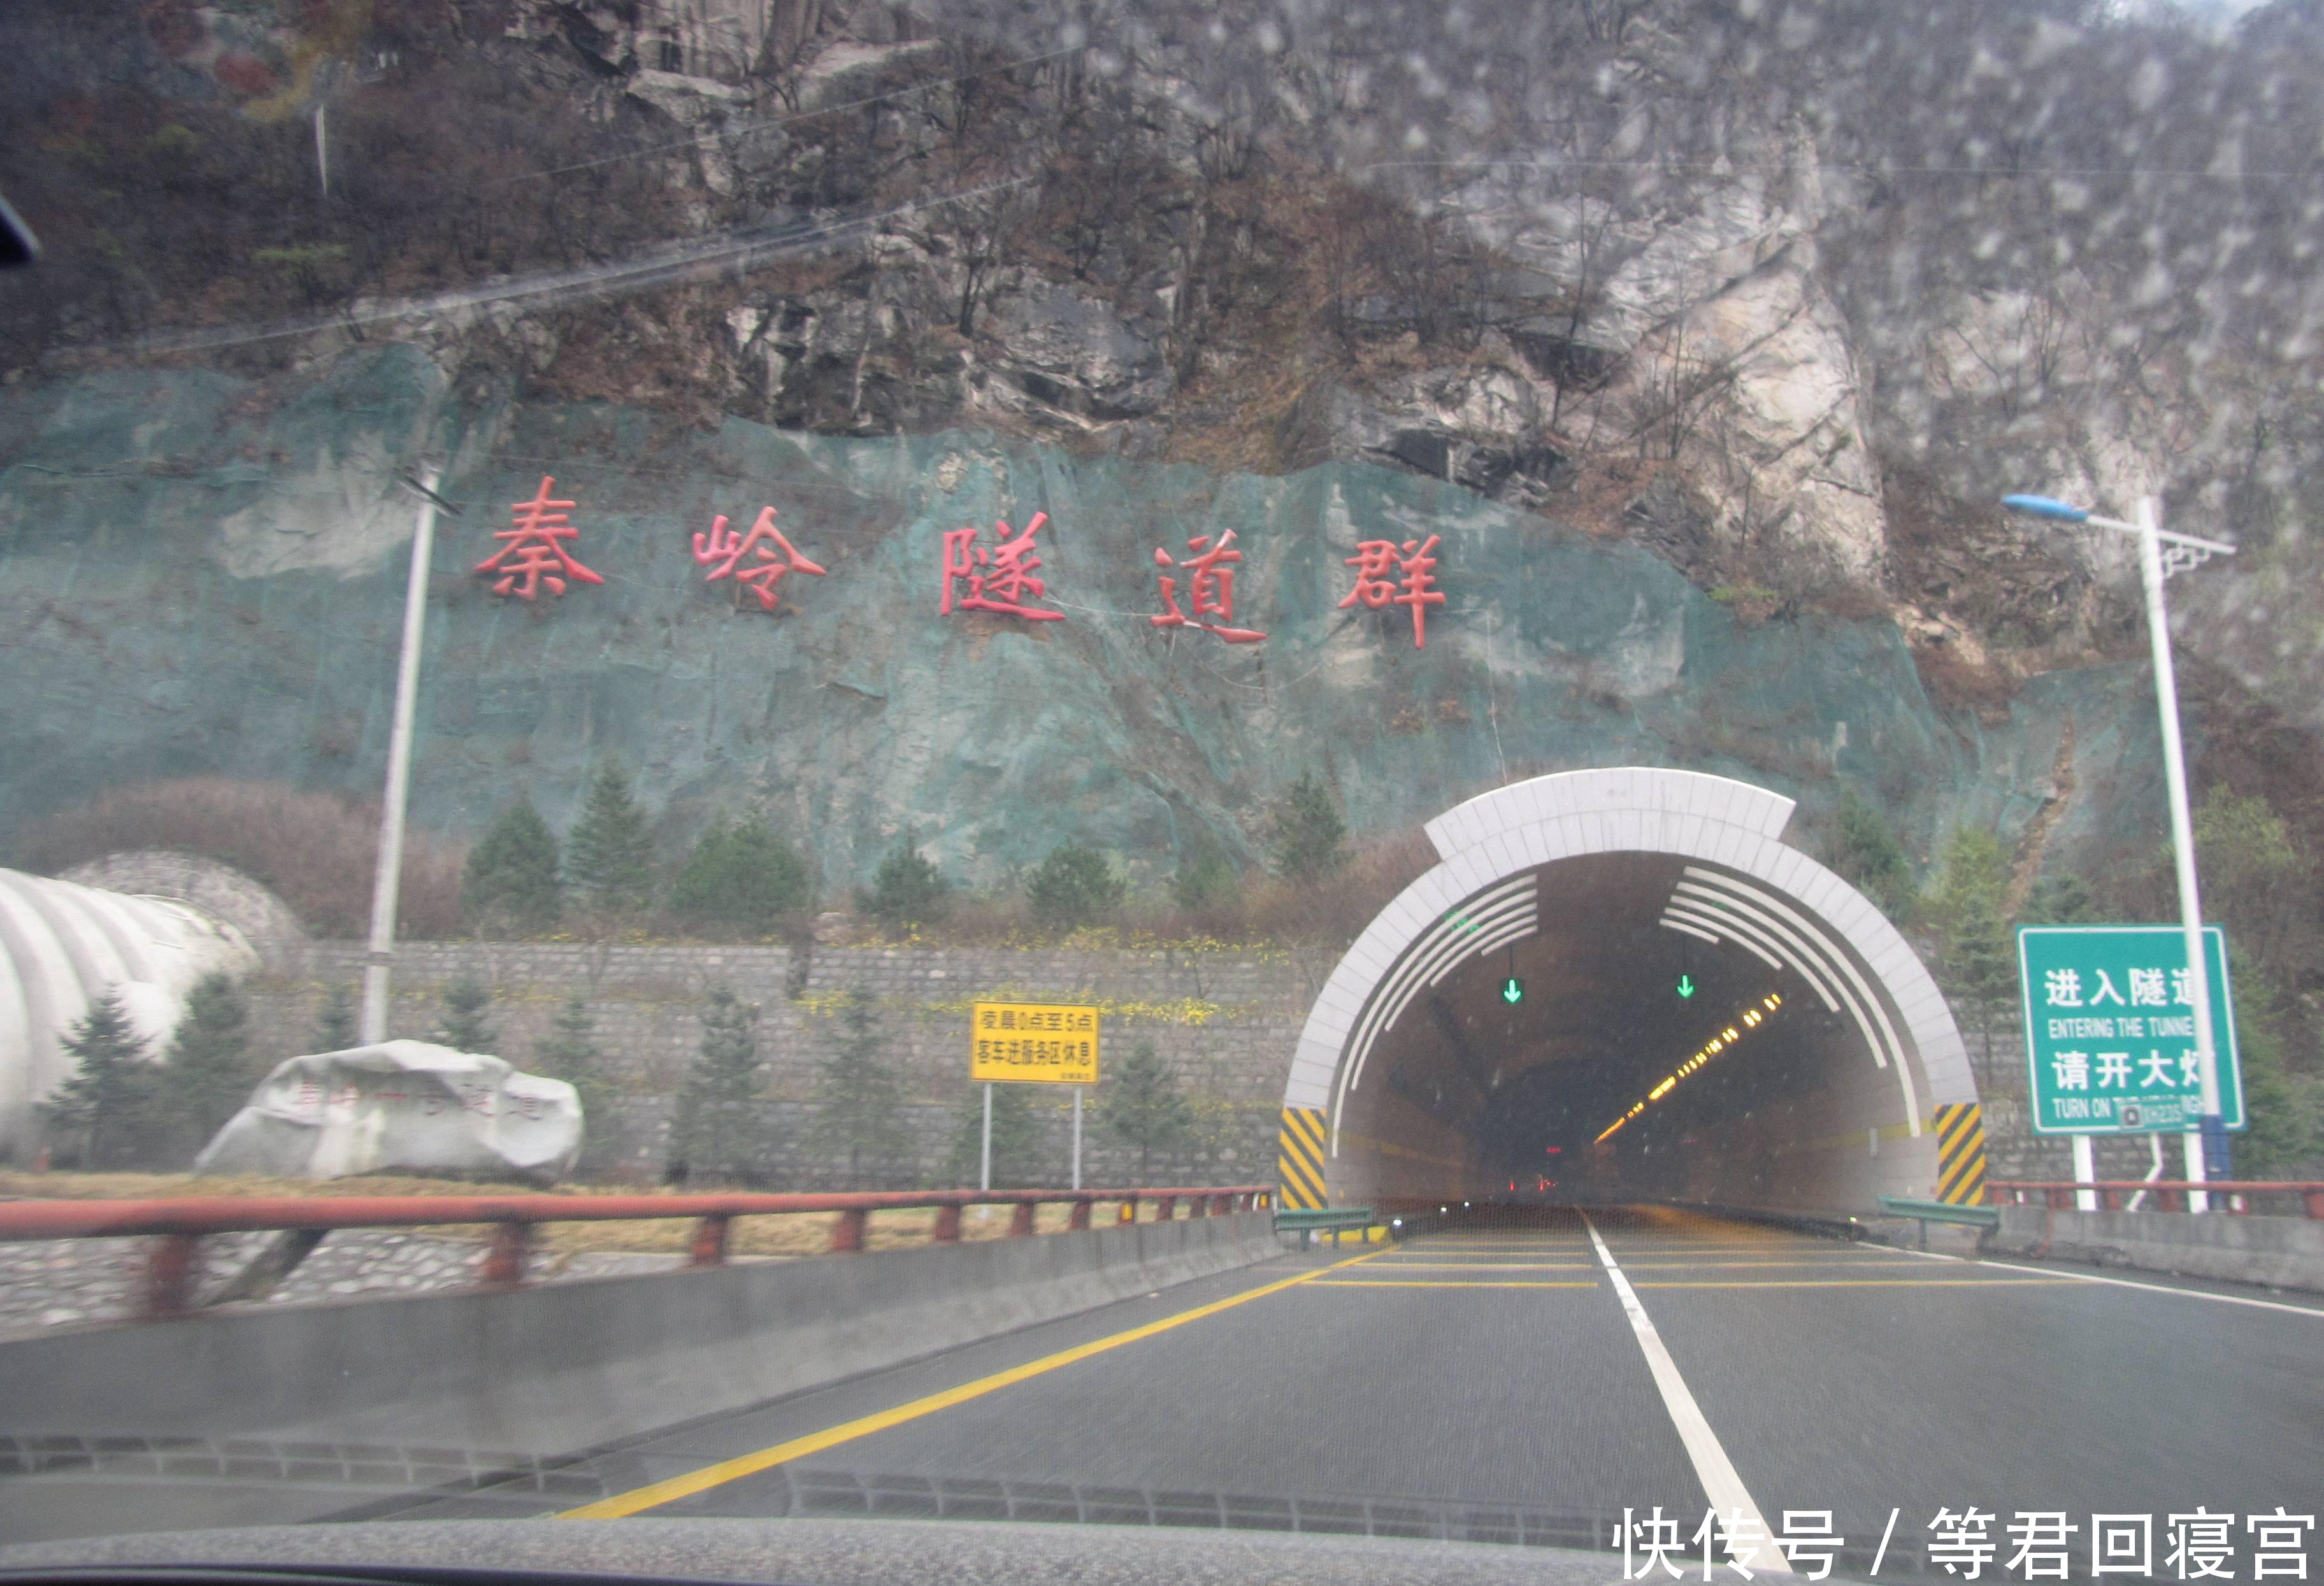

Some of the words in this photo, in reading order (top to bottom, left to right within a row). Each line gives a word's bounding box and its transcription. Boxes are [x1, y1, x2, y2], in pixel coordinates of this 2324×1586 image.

[474, 476, 1446, 650] 秦岭隧道群
[2048, 1018, 2114, 1039] ENTERING
[2118, 1017, 2144, 1037] THE
[2149, 1016, 2196, 1036] TUNNE
[978, 1039, 1091, 1066] 客车进服务区休息
[2052, 1098, 2090, 1119] TURN
[2092, 1097, 2111, 1117] ON
